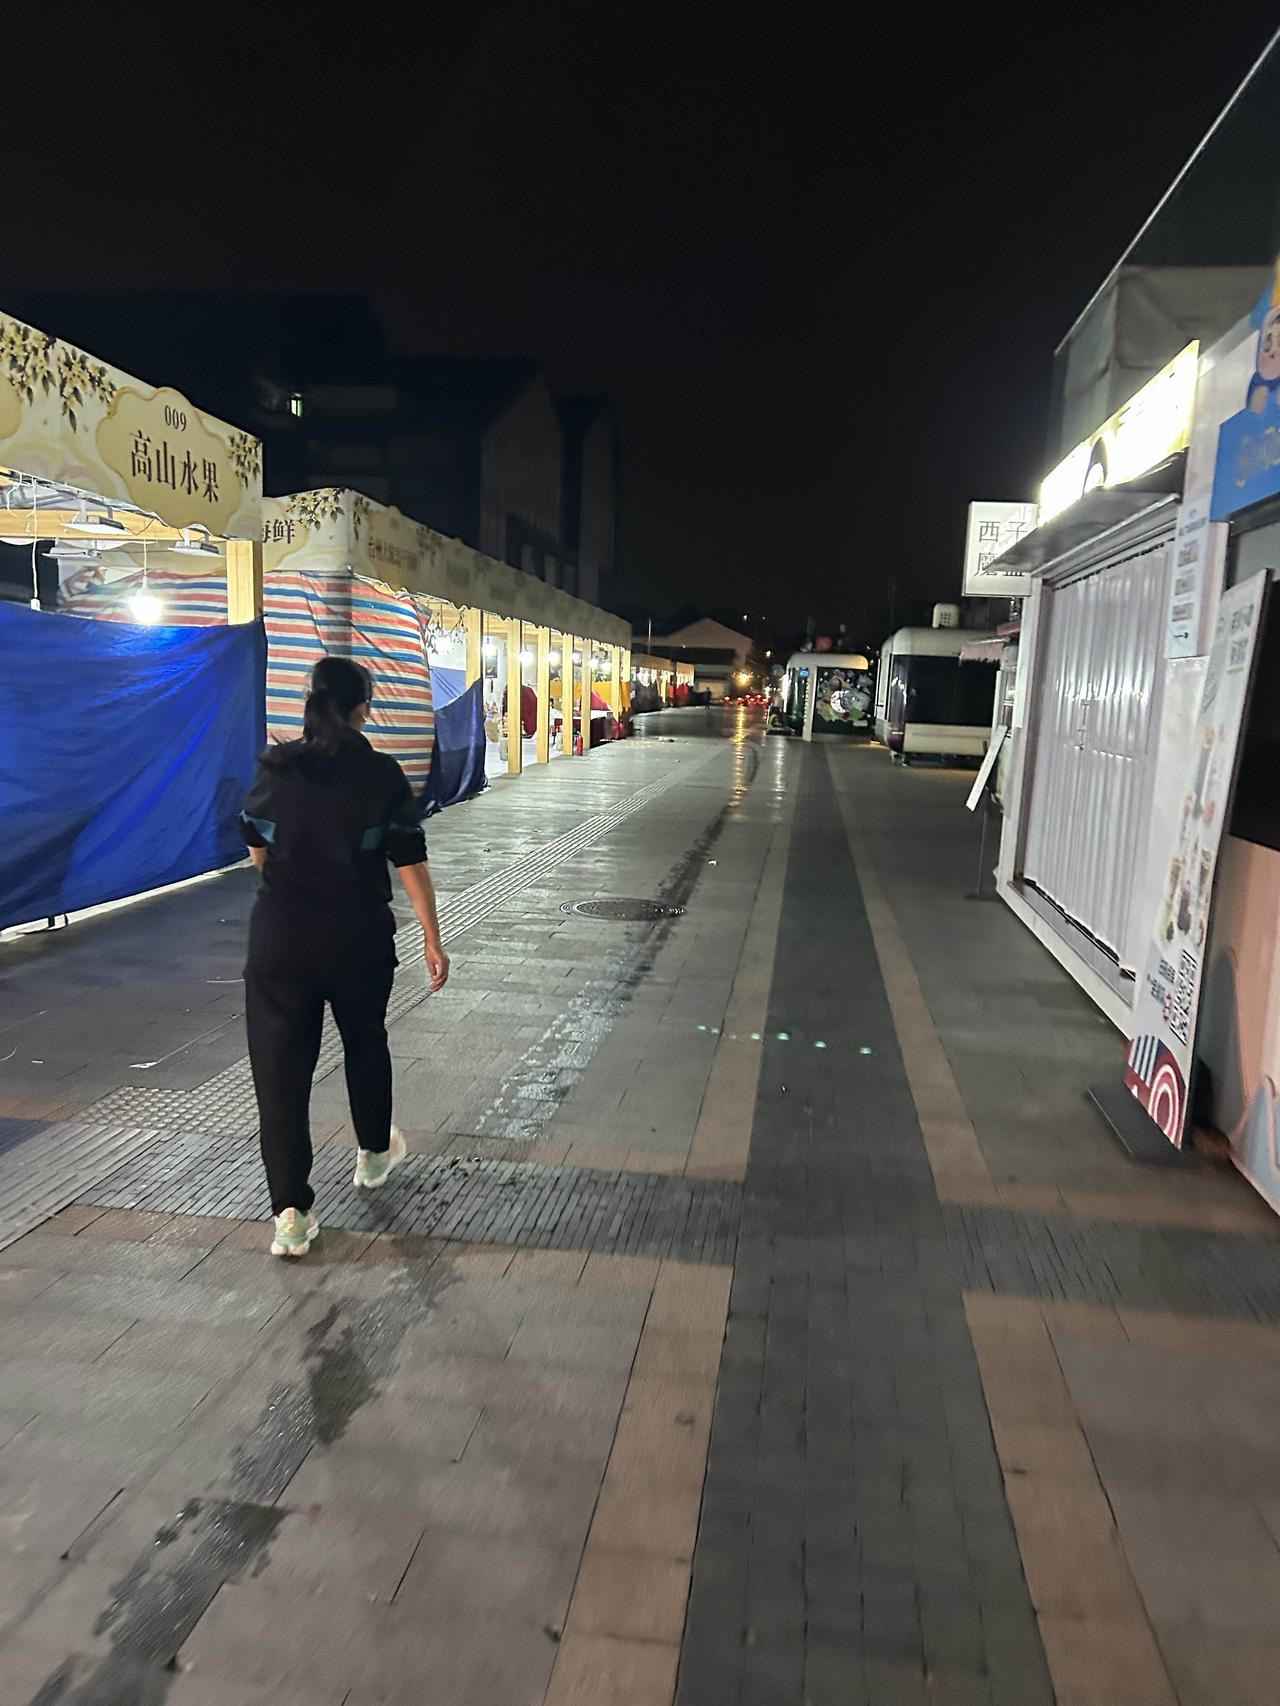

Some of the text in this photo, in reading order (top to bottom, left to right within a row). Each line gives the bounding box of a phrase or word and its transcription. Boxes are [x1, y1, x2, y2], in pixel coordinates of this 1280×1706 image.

[164, 405, 187, 432] 009
[130, 429, 219, 503] 高山水果
[978, 520, 1029, 543] 西子
